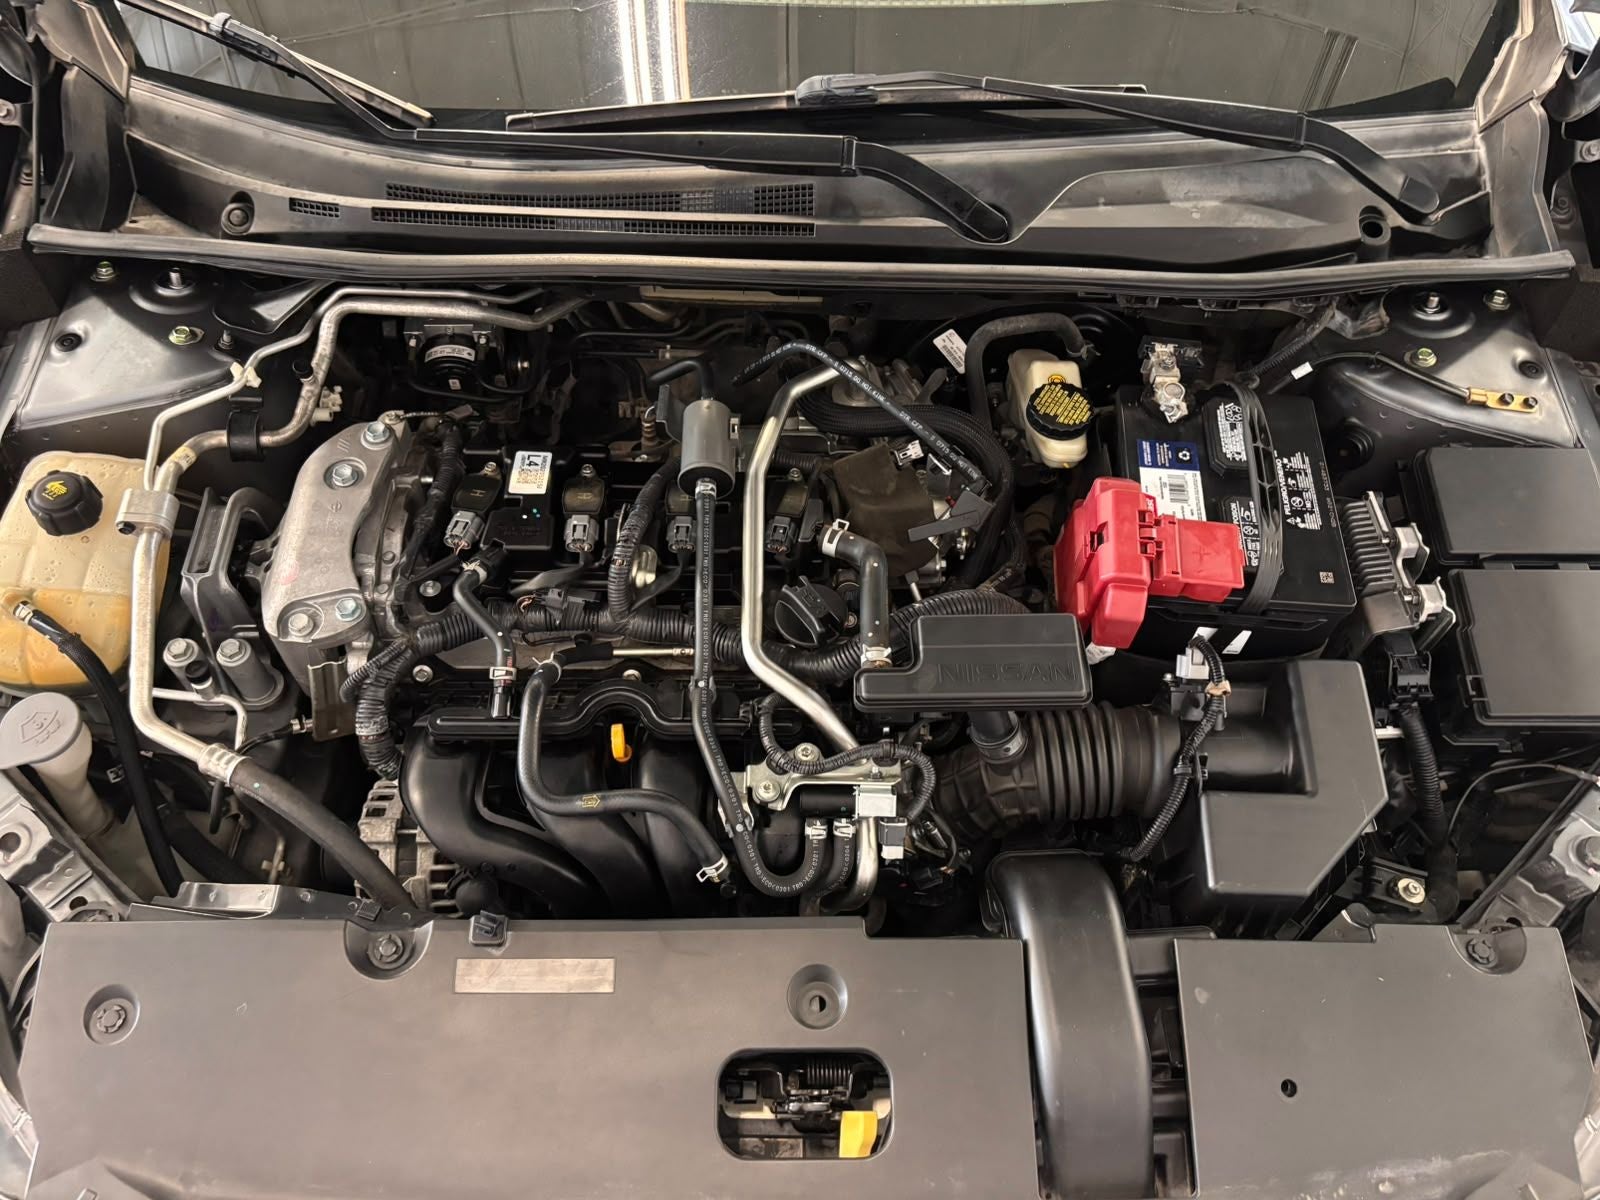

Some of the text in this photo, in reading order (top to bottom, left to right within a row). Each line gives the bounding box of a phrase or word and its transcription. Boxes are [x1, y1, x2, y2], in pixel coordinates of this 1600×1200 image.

[935, 440, 950, 455] 0715
[526, 454, 542, 467] L4
[1230, 502, 1240, 525] POISON
[937, 661, 1078, 683] NISSAN
